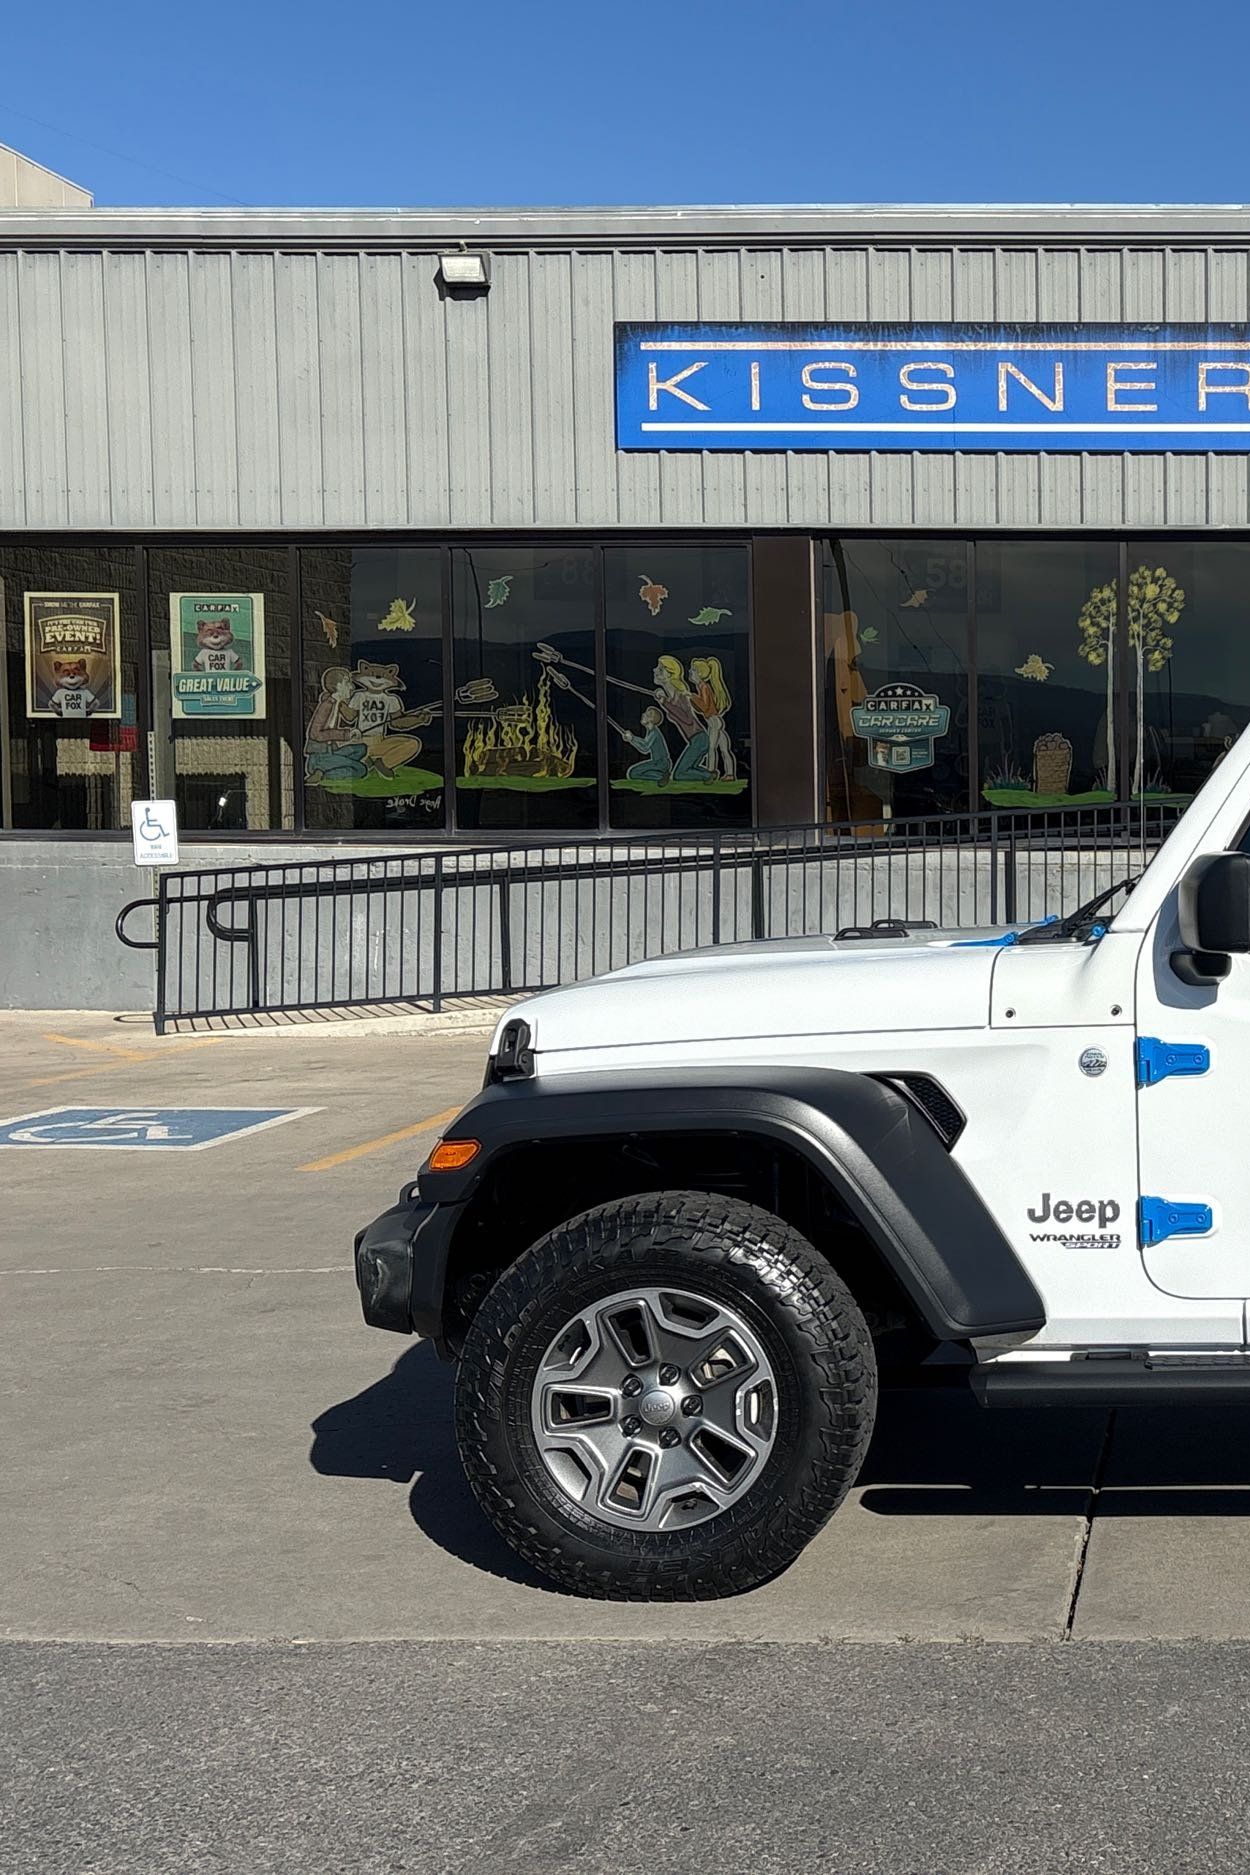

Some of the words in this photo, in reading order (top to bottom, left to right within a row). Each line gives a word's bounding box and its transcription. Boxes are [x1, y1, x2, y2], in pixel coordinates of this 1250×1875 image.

[195, 603, 239, 613] CARFAX
[44, 624, 101, 633] PRE-OWNED
[45, 631, 101, 643] EVENT!
[208, 653, 226, 662] CAR
[209, 662, 226, 671] FOX
[178, 679, 213, 693] GREAT
[216, 677, 250, 692] VALUE
[64, 693, 82, 701] CAR
[65, 702, 82, 710] FOX
[867, 700, 934, 711] CARFAX
[859, 715, 893, 727] CAR
[895, 714, 940, 727] CARE
[1027, 1192, 1121, 1229] Jeep
[1029, 1233, 1121, 1242] WRANGLER
[643, 1402, 671, 1413] Jeep
